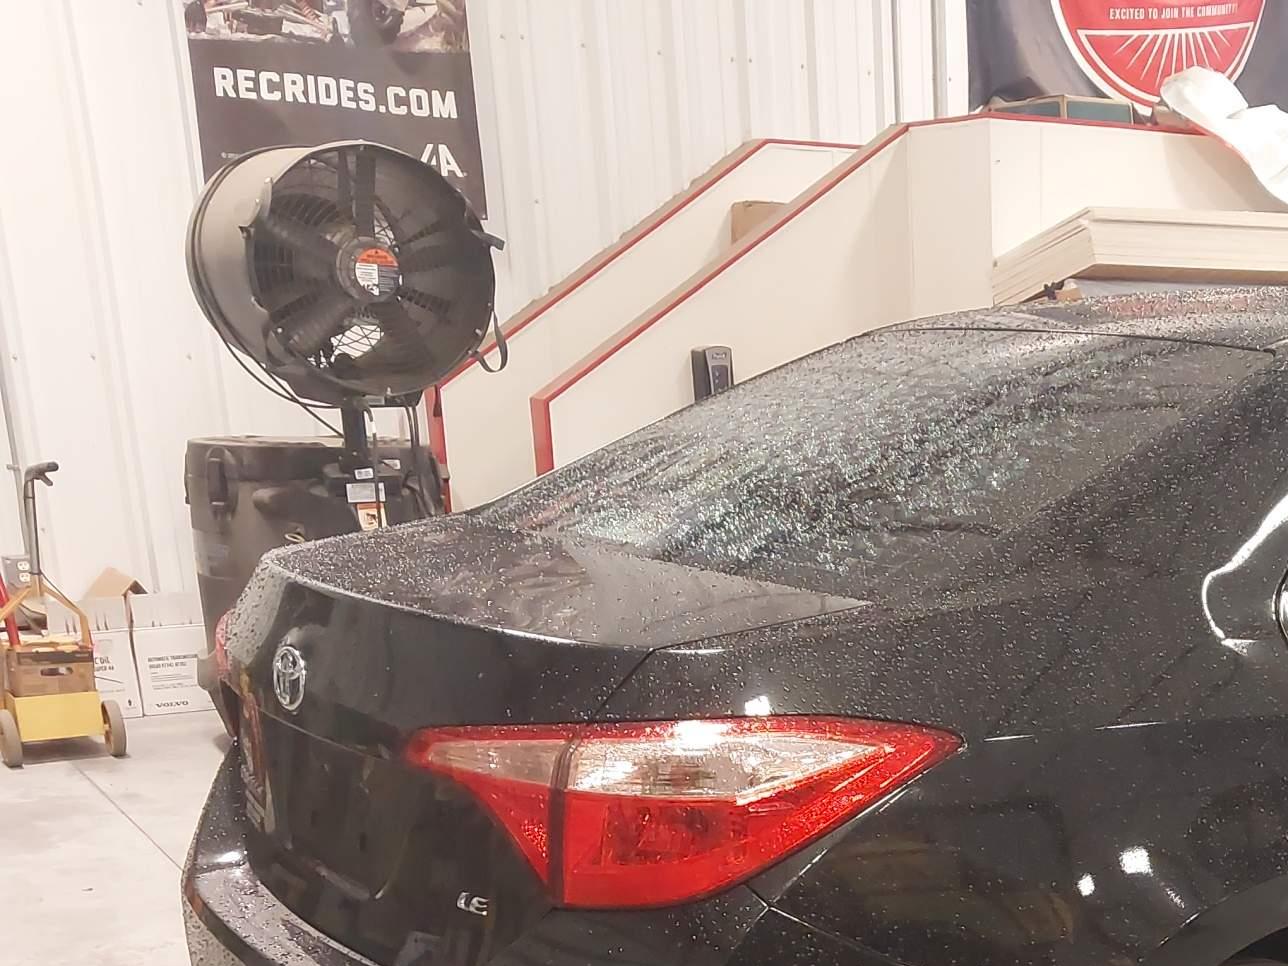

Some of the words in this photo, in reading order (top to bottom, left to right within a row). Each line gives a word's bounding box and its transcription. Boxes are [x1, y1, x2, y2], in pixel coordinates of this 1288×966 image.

[1109, 7, 1145, 20] EXCITED
[1148, 7, 1158, 19] TO
[1161, 7, 1179, 19] JOIN
[1181, 6, 1194, 18] THE
[213, 66, 458, 118] RECRIDES.COM
[155, 700, 189, 708] VOLVO
[456, 891, 489, 916] LE
